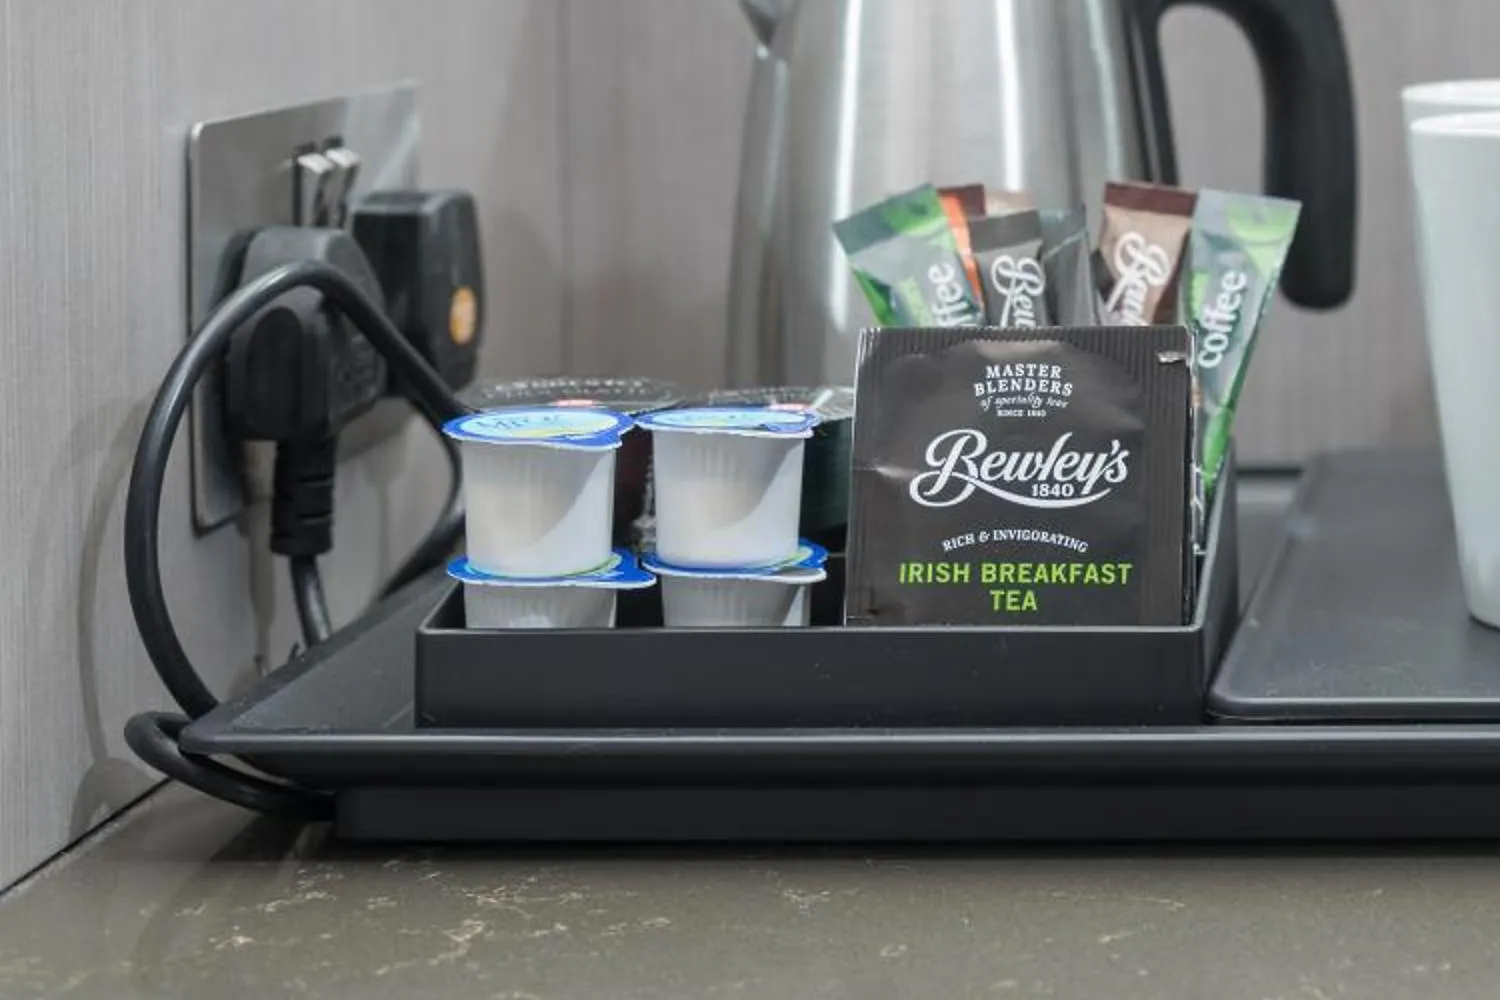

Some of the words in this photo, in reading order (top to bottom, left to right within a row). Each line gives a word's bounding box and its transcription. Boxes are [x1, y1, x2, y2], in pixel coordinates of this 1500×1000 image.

[928, 262, 977, 327] ffee
[1198, 270, 1248, 368] coffee
[985, 363, 1062, 379] MASTER
[974, 378, 1074, 397] BLENDERS
[909, 428, 1130, 508] Bewley's
[1031, 483, 1075, 497] 1840
[942, 533, 975, 552] RICH
[979, 530, 991, 543] &
[993, 529, 1090, 553] INVIGORATING
[899, 562, 971, 585] IRISH
[980, 562, 1133, 585] BREAKFAST
[990, 588, 1038, 612] TEA
